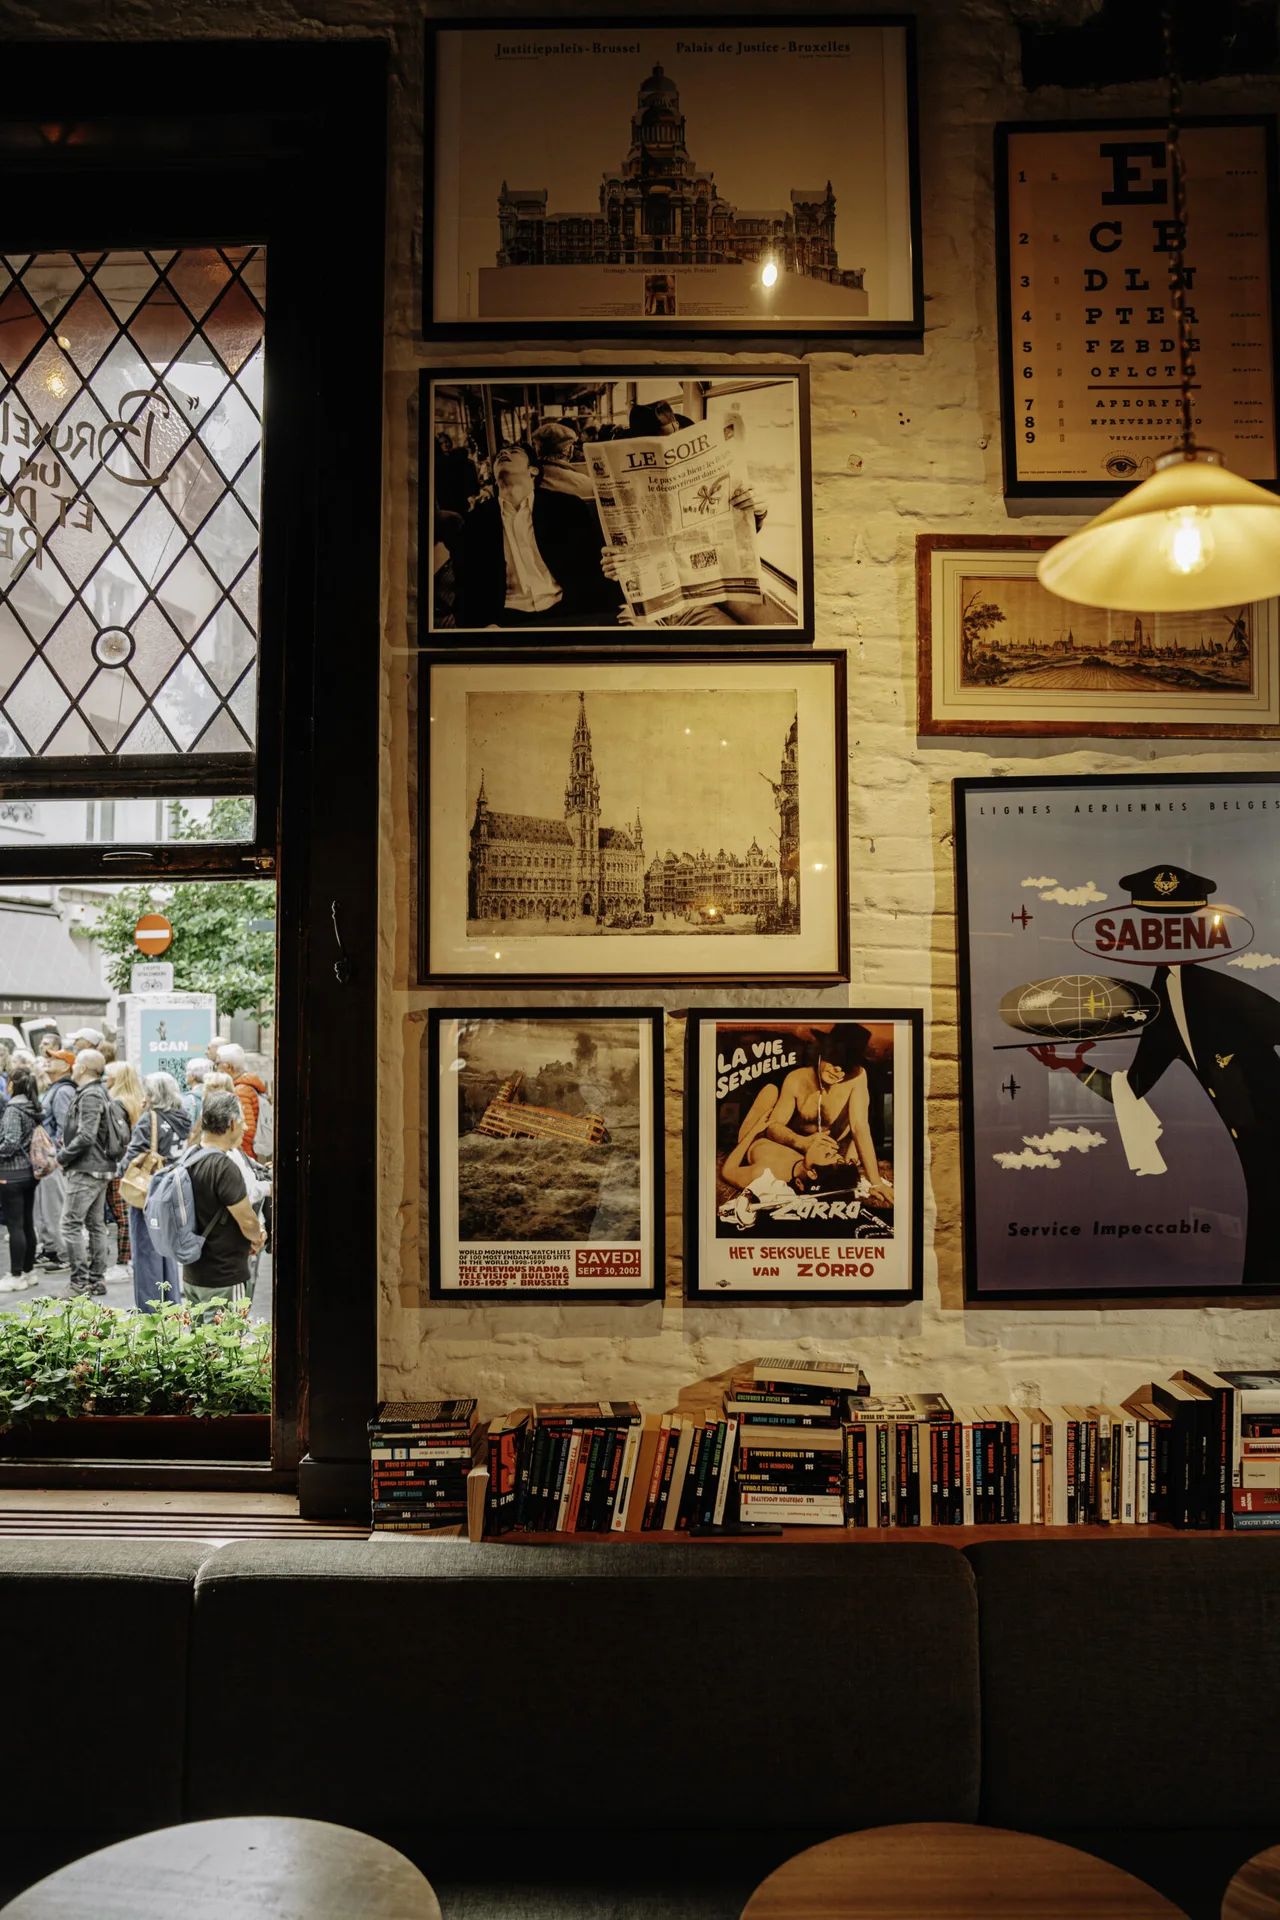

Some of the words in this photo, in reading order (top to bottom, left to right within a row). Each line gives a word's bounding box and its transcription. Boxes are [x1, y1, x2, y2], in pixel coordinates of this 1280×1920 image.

[676, 41, 713, 53] Palais
[718, 41, 733, 53] de
[1018, 171, 1027, 183] 1
[1100, 142, 1168, 206] E
[1019, 233, 1029, 245] 2
[1020, 276, 1030, 288] 3
[1021, 310, 1032, 323] 4
[1022, 341, 1032, 353] 5
[1023, 366, 1033, 379] 6
[1024, 398, 1034, 411] 7
[1025, 416, 1035, 429] 8
[1025, 431, 1036, 444] 9
[626, 451, 657, 469] LE
[663, 434, 711, 466] SOIR
[648, 476, 659, 484] Le
[660, 476, 677, 485] pays
[980, 805, 1051, 815] LIGNES
[1094, 917, 1232, 952] SABENA
[149, 1041, 189, 1052] SCAN
[717, 1048, 748, 1075] LA
[751, 1039, 784, 1059] VIE
[716, 1051, 798, 1099] SEXUELLE
[770, 1201, 862, 1220] ZORRO
[1007, 1222, 1082, 1237] Service
[1093, 1219, 1212, 1238] Impeccable
[577, 1252, 640, 1264] SAVED!
[729, 1246, 755, 1260] HET
[760, 1246, 831, 1260] SEKSUELE
[837, 1246, 885, 1260] LEVEN
[459, 1272, 517, 1280] TELEVISION
[520, 1272, 570, 1280] BUILDING
[578, 1267, 601, 1275] SEPT
[604, 1267, 617, 1276] 30,
[619, 1267, 640, 1275] 2002
[752, 1267, 780, 1277] VAN
[797, 1263, 875, 1278] ZORRO
[459, 1279, 508, 1287] 1935-1995
[520, 1279, 570, 1287] BRUSSELS
[1068, 1477, 1074, 1485] LA
